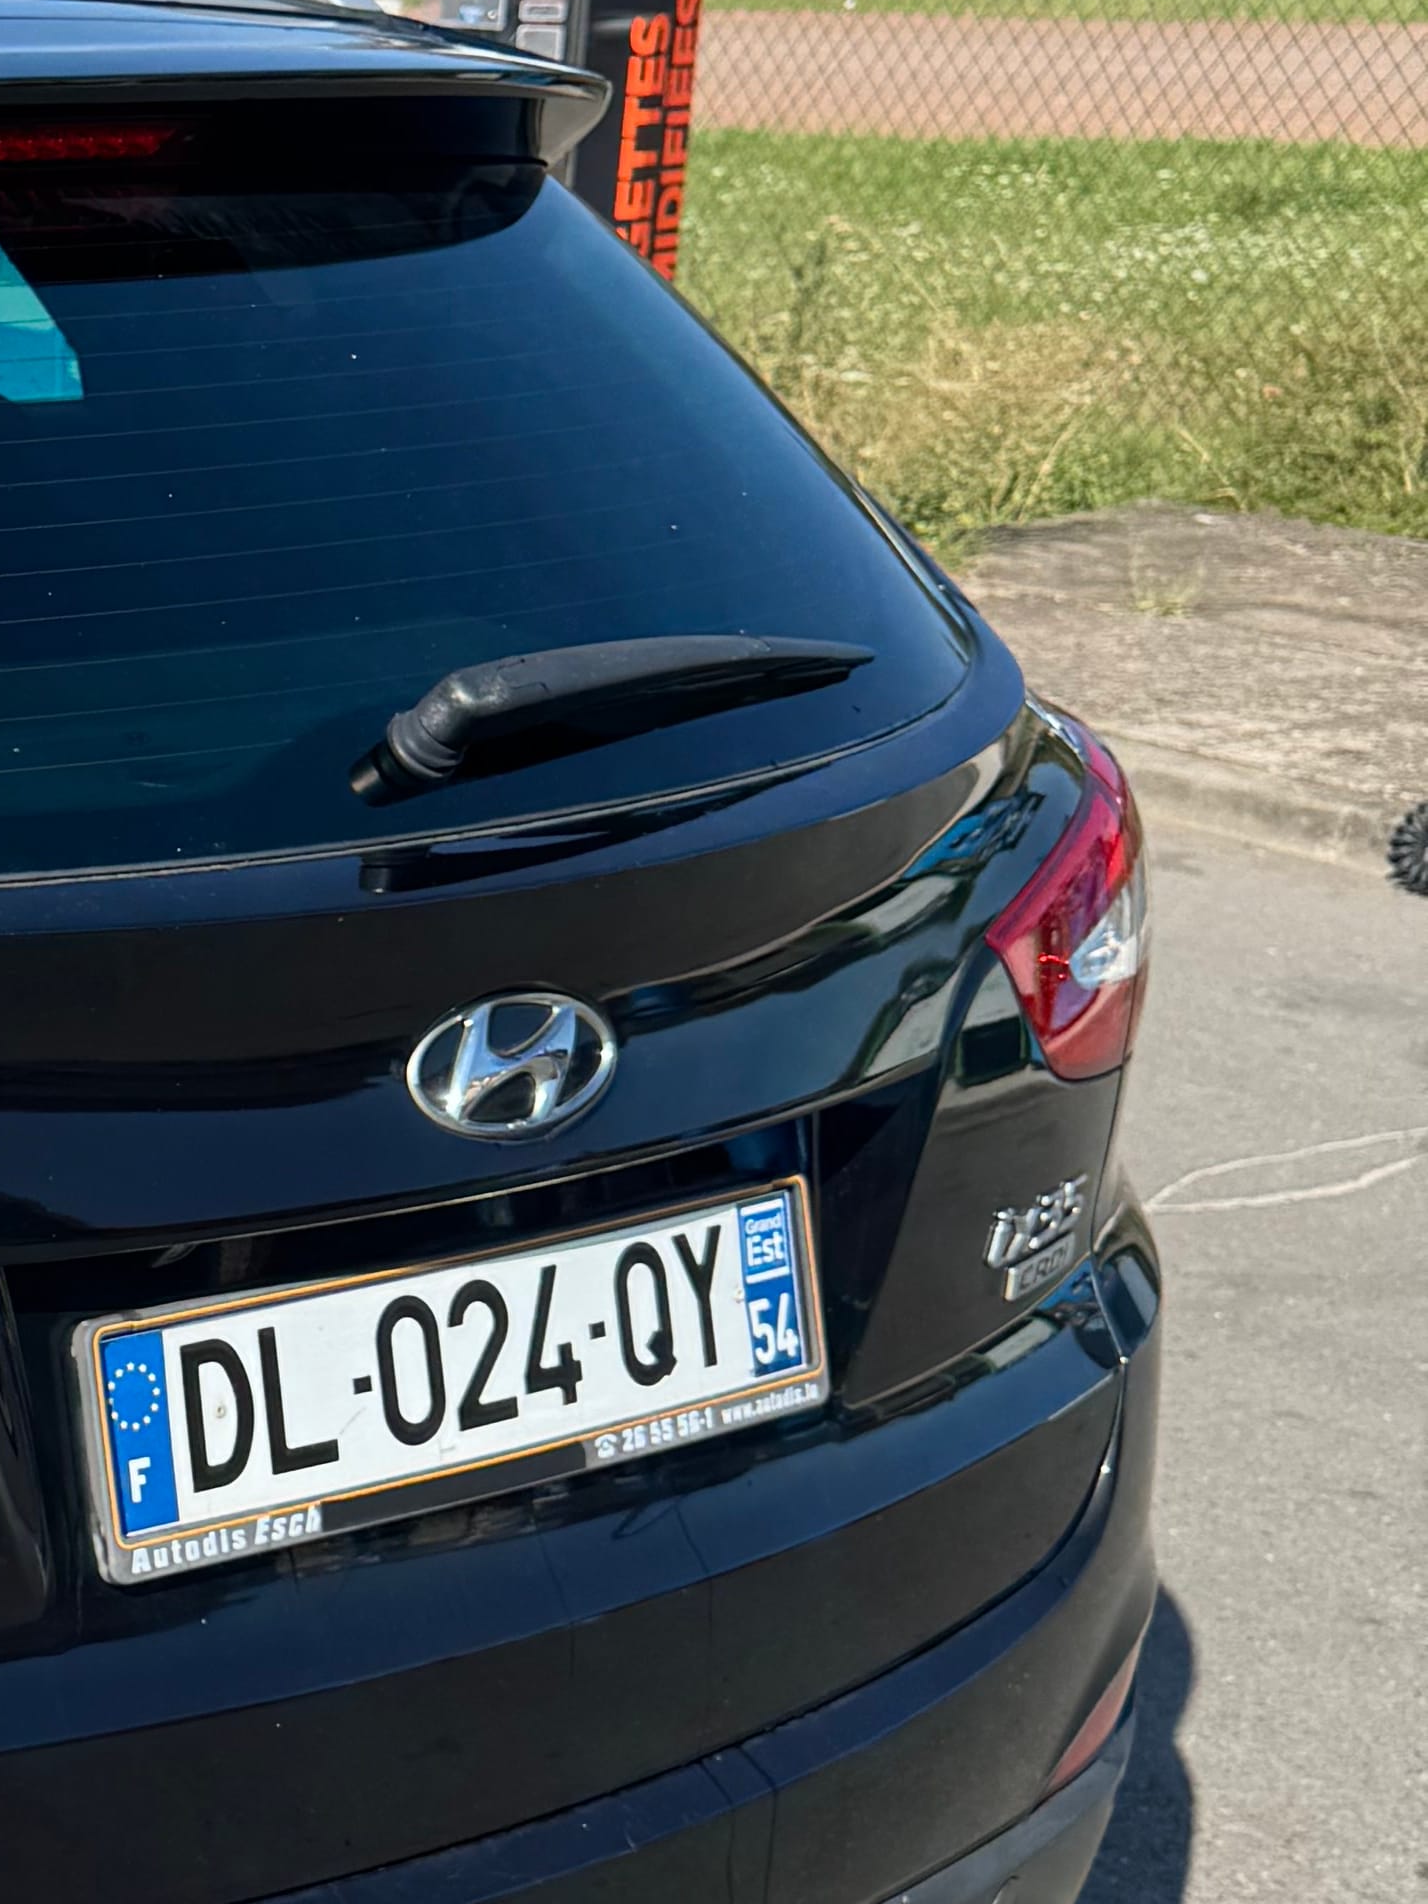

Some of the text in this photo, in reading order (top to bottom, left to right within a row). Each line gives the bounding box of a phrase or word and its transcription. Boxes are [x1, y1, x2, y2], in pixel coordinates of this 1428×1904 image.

[745, 1213, 782, 1236] Grand
[746, 1231, 785, 1267] Est
[748, 1292, 799, 1365] 54
[178, 1224, 725, 1495] DL-024-QY
[128, 1455, 151, 1504] F
[132, 1504, 323, 1575] Autodis Esch
